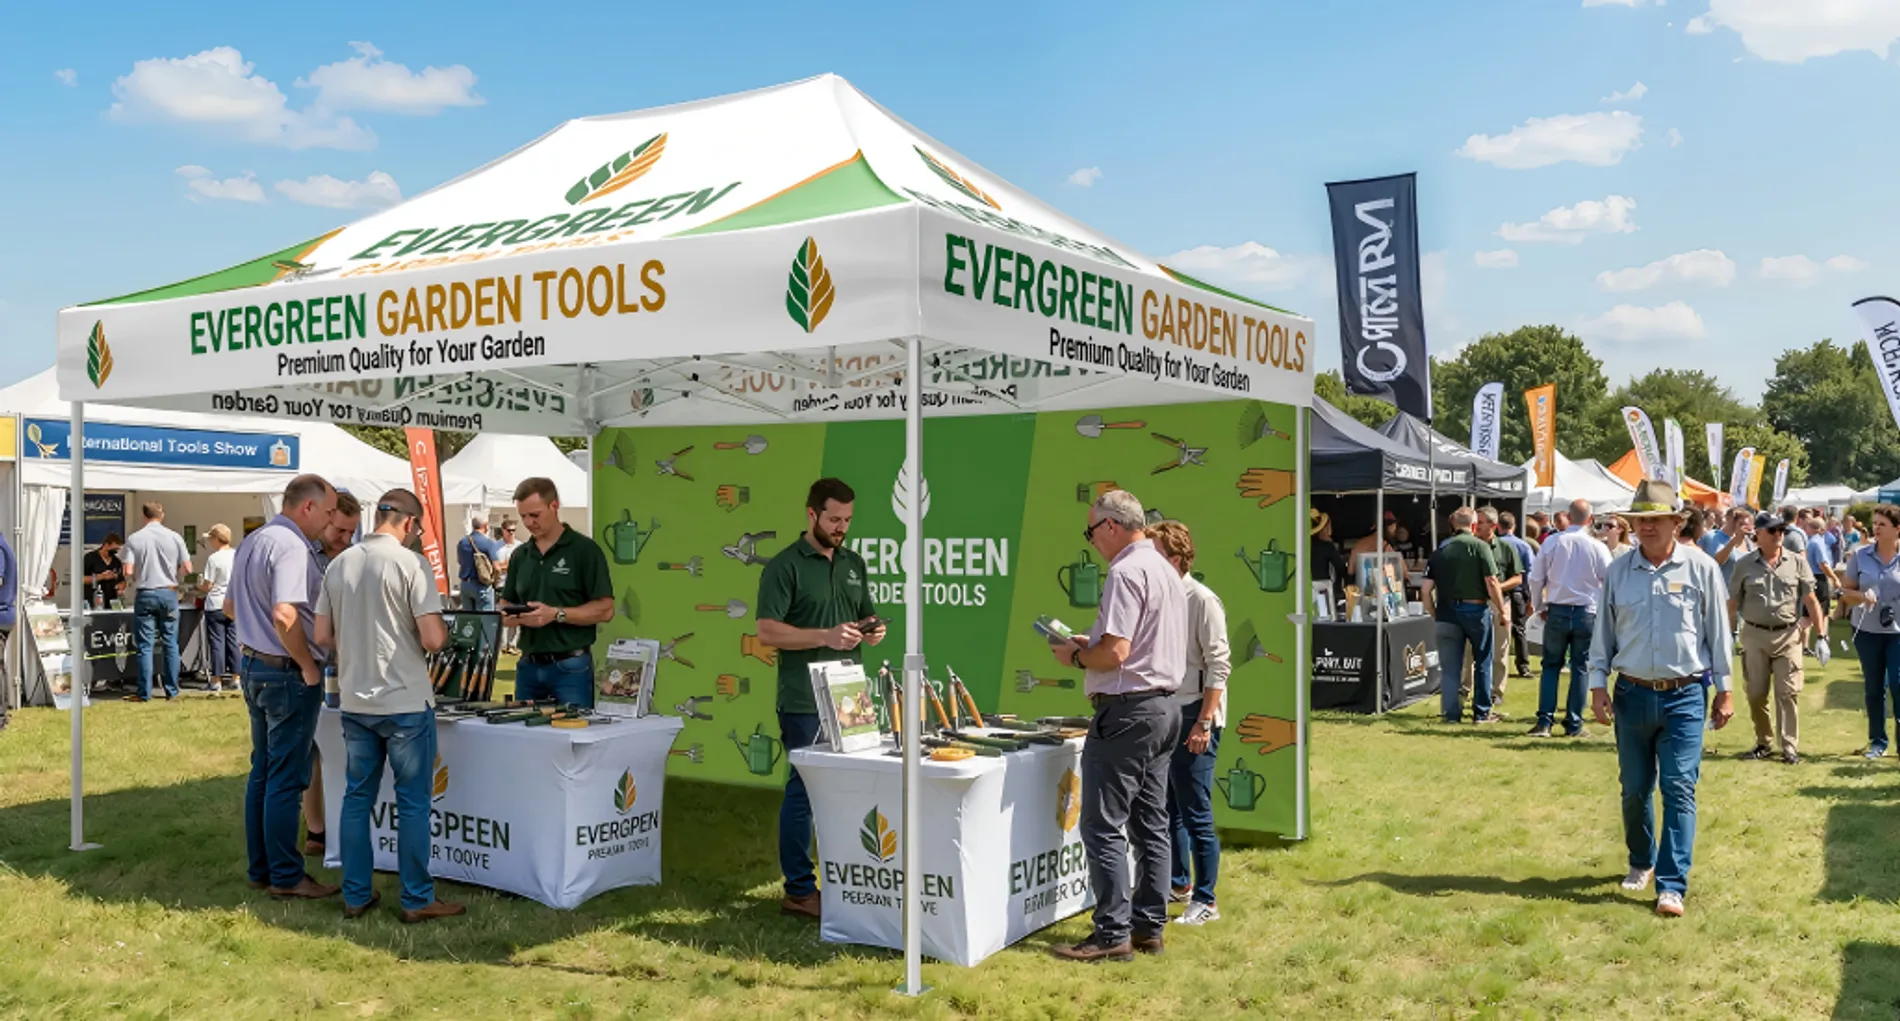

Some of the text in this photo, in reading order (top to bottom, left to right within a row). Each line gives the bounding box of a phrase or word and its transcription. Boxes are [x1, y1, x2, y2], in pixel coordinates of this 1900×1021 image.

[349, 181, 742, 261] EVERGREEN
[190, 259, 667, 356] EVERGREEN GARDEN TOOLS
[945, 232, 1307, 373] EVERGREEN GARDEN TOOLS
[278, 331, 545, 377] Premium Quality for Your Garden
[1050, 327, 1250, 393] Premium Quality for Your Garden
[67, 435, 258, 457] Iternational Tools Show
[922, 583, 988, 606] TOOLS
